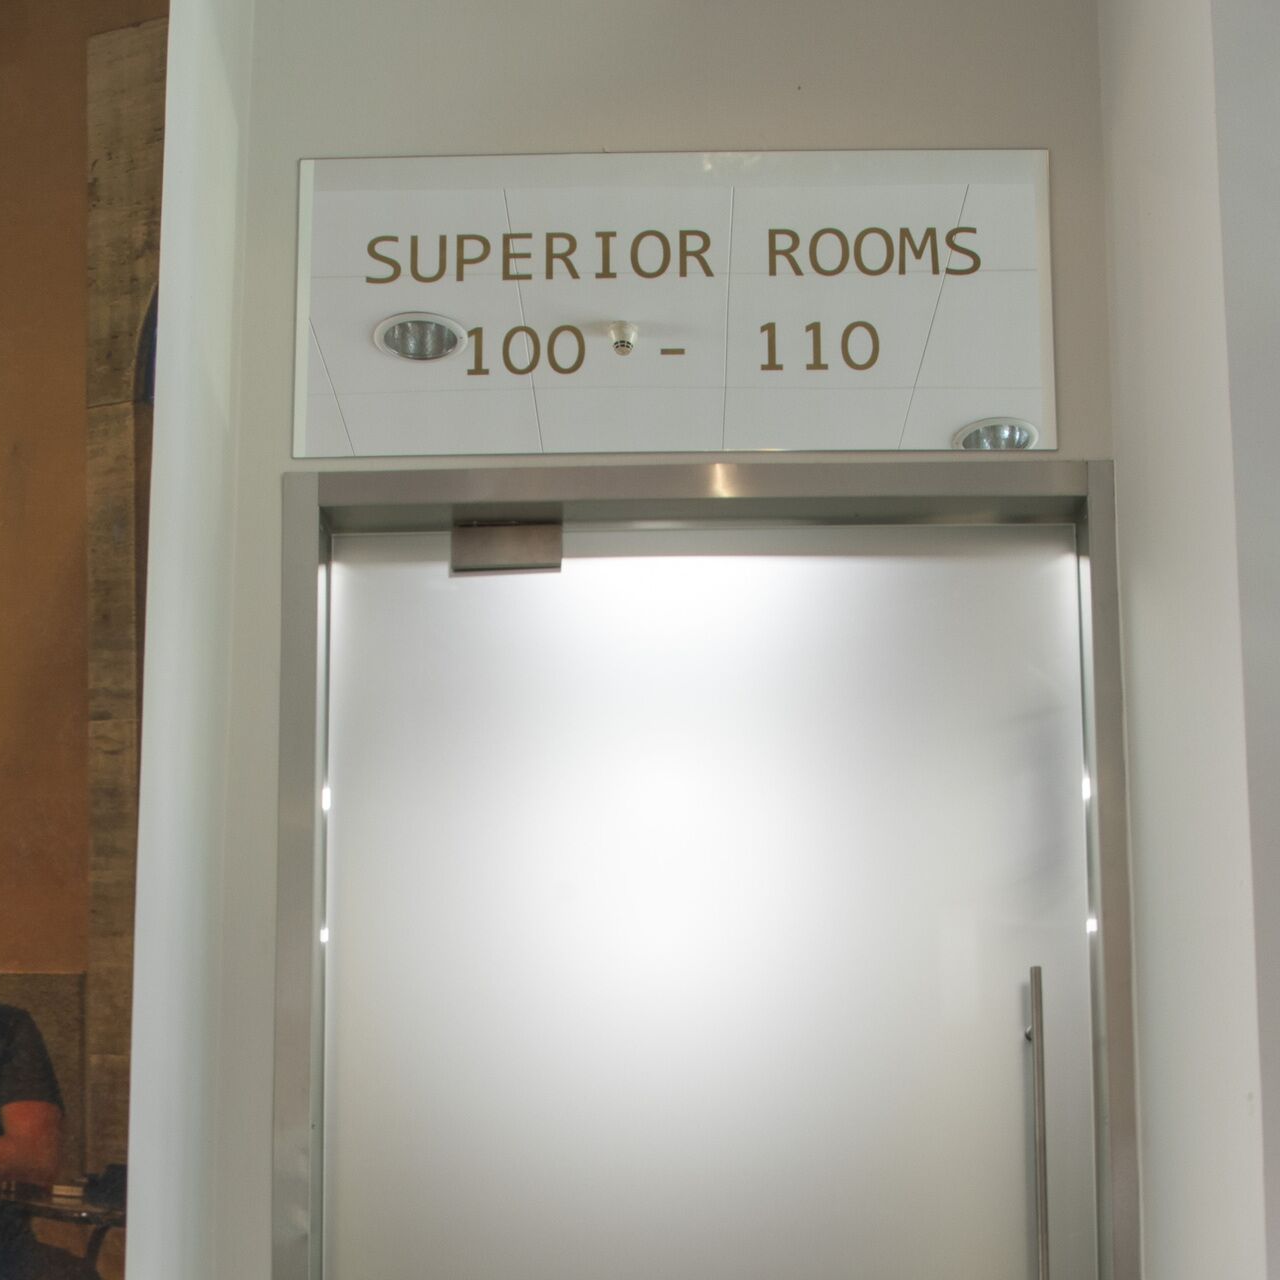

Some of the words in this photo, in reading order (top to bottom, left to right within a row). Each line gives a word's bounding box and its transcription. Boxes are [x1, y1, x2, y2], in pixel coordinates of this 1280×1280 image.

[366, 229, 714, 285] SUPERIOR
[768, 226, 982, 277] ROOMS
[466, 324, 586, 376] 100
[760, 320, 880, 371] 110
